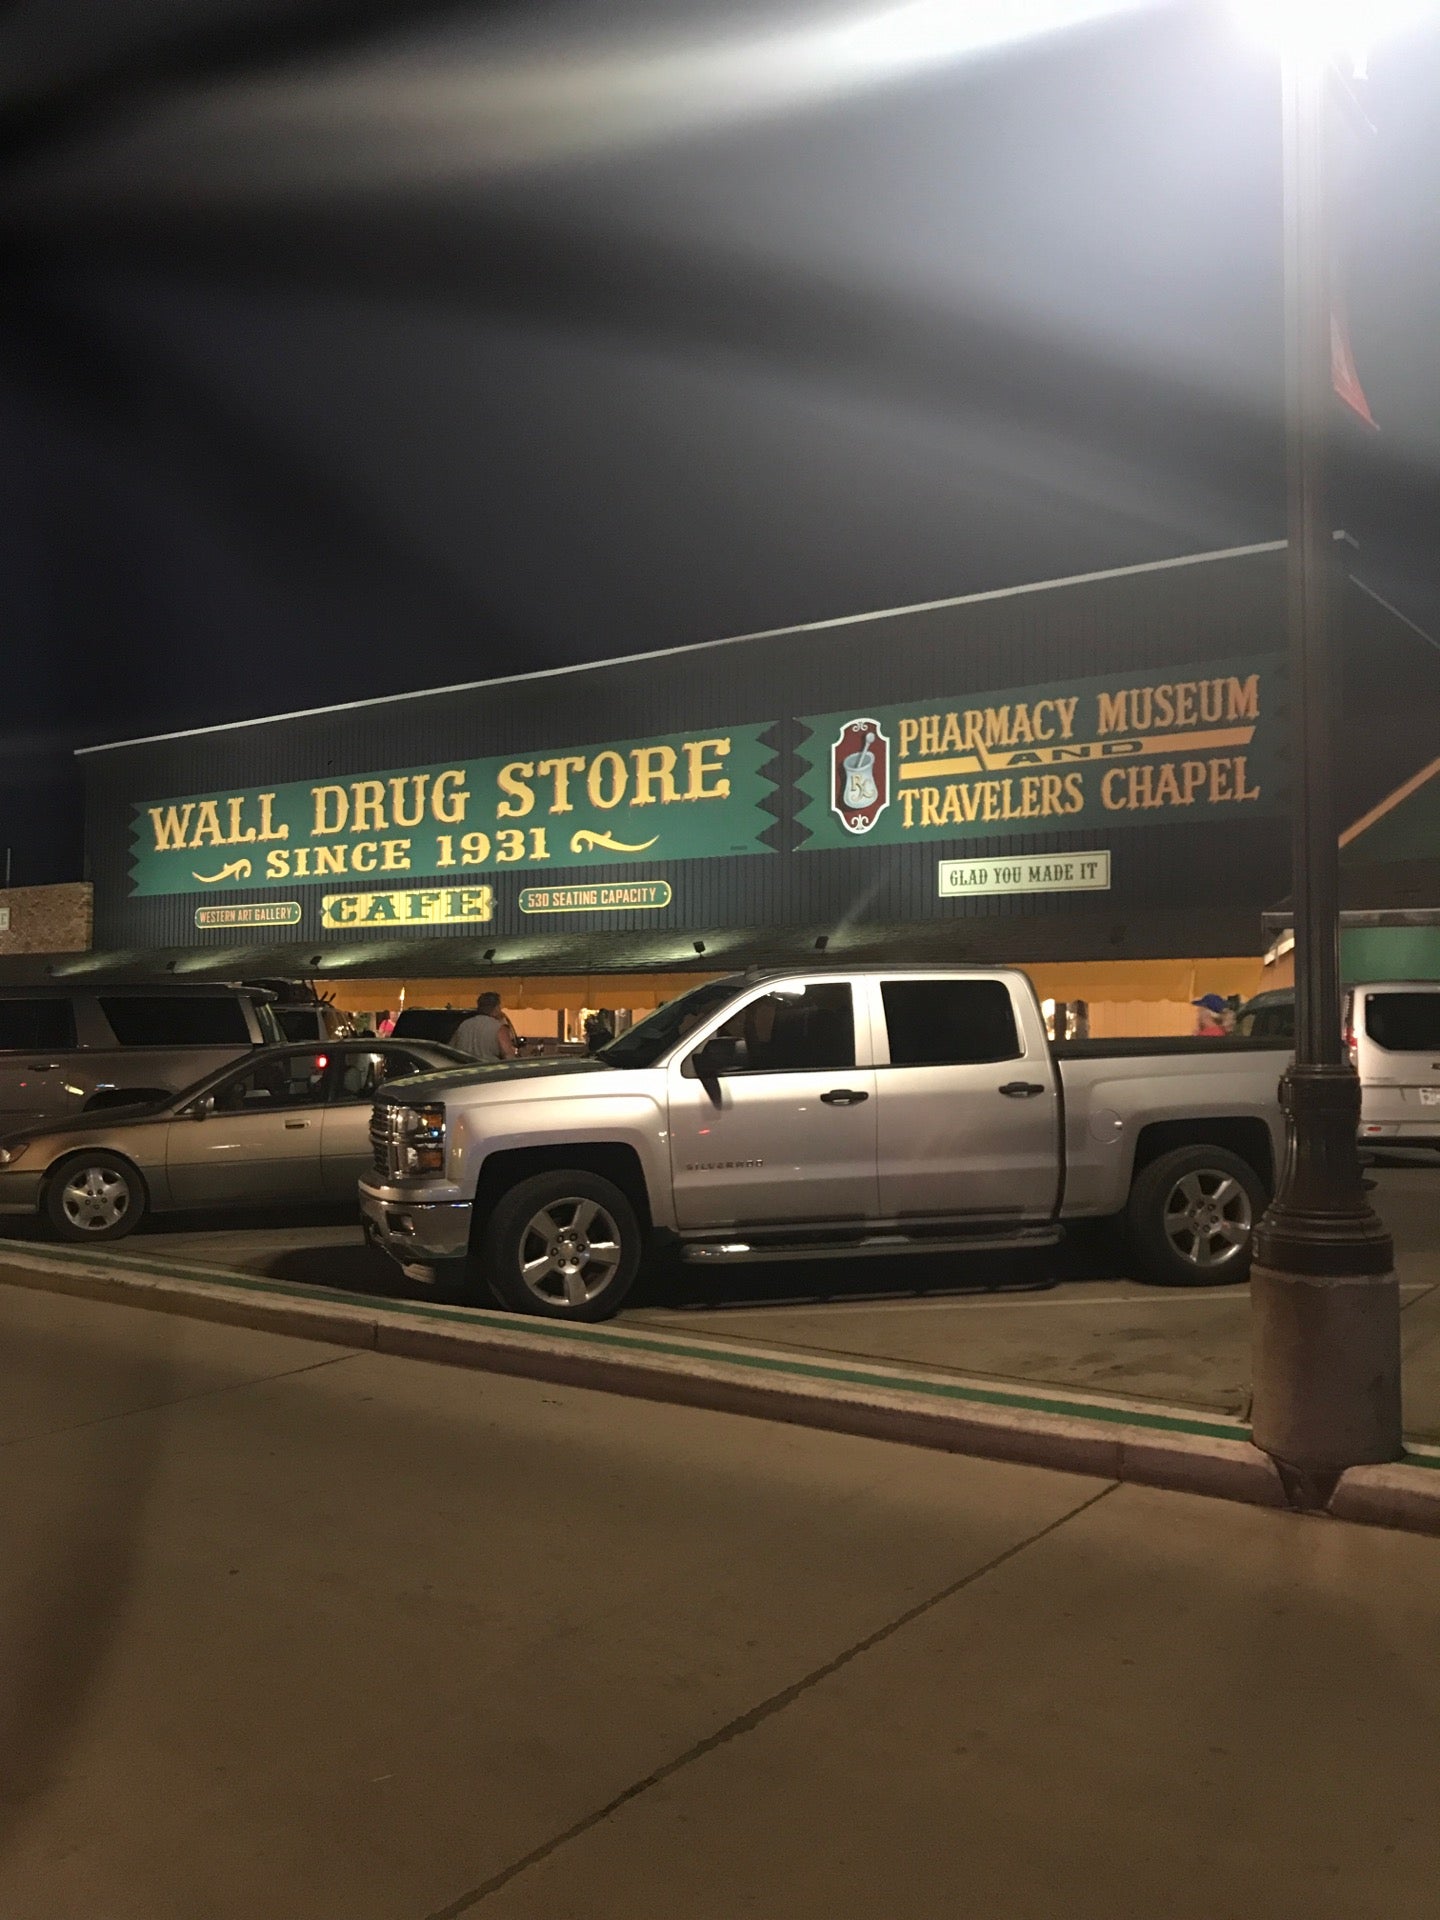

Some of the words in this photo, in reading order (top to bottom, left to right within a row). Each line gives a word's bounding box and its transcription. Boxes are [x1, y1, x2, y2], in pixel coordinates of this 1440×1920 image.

[899, 697, 1079, 757] PHARMACY
[1097, 674, 1260, 735] MUSEUM
[1007, 740, 1144, 766] AND
[148, 793, 289, 851] WALL
[310, 770, 470, 837] DRUG
[497, 737, 731, 819] STORE
[898, 773, 1084, 829] TRAVELERS
[1101, 756, 1260, 810] CHAPEL
[266, 839, 411, 879] SINCE
[437, 827, 550, 867] 1931
[950, 868, 988, 886] GLAD
[994, 867, 1021, 884] YOU
[1029, 864, 1073, 882] MADE
[1080, 862, 1098, 879] IT
[329, 890, 482, 922] CAFE
[528, 893, 549, 907] 530
[552, 890, 597, 906] SEATING
[601, 888, 656, 904] CAPACITY
[200, 911, 236, 923] WESTERN
[238, 909, 253, 921] ART
[255, 907, 292, 920] GALLERY
